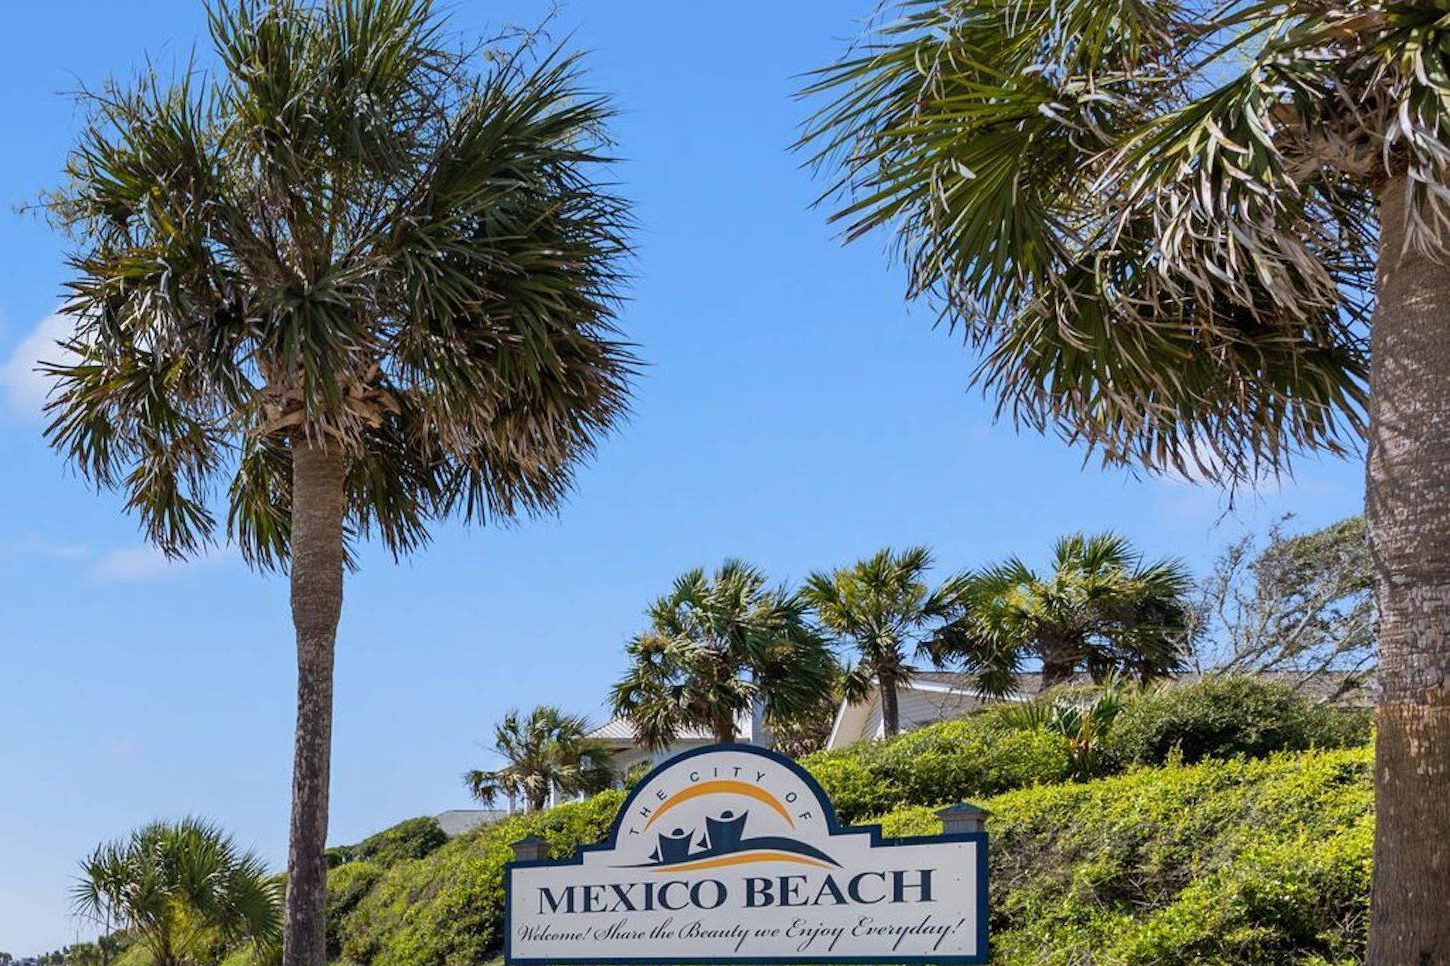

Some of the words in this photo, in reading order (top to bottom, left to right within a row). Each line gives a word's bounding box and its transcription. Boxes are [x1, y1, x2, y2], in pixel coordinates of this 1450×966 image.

[629, 789, 668, 836] THE
[690, 767, 766, 783] CITY
[785, 792, 812, 825] OF
[537, 879, 728, 914] MEXICO
[742, 869, 938, 909] BEACH
[518, 922, 592, 942] Welcome!
[593, 917, 646, 941] Share
[649, 916, 674, 939] the
[678, 919, 750, 952] Beauty
[754, 929, 781, 938] we
[785, 918, 845, 952] Enjoy
[851, 915, 966, 951] Everyday!
